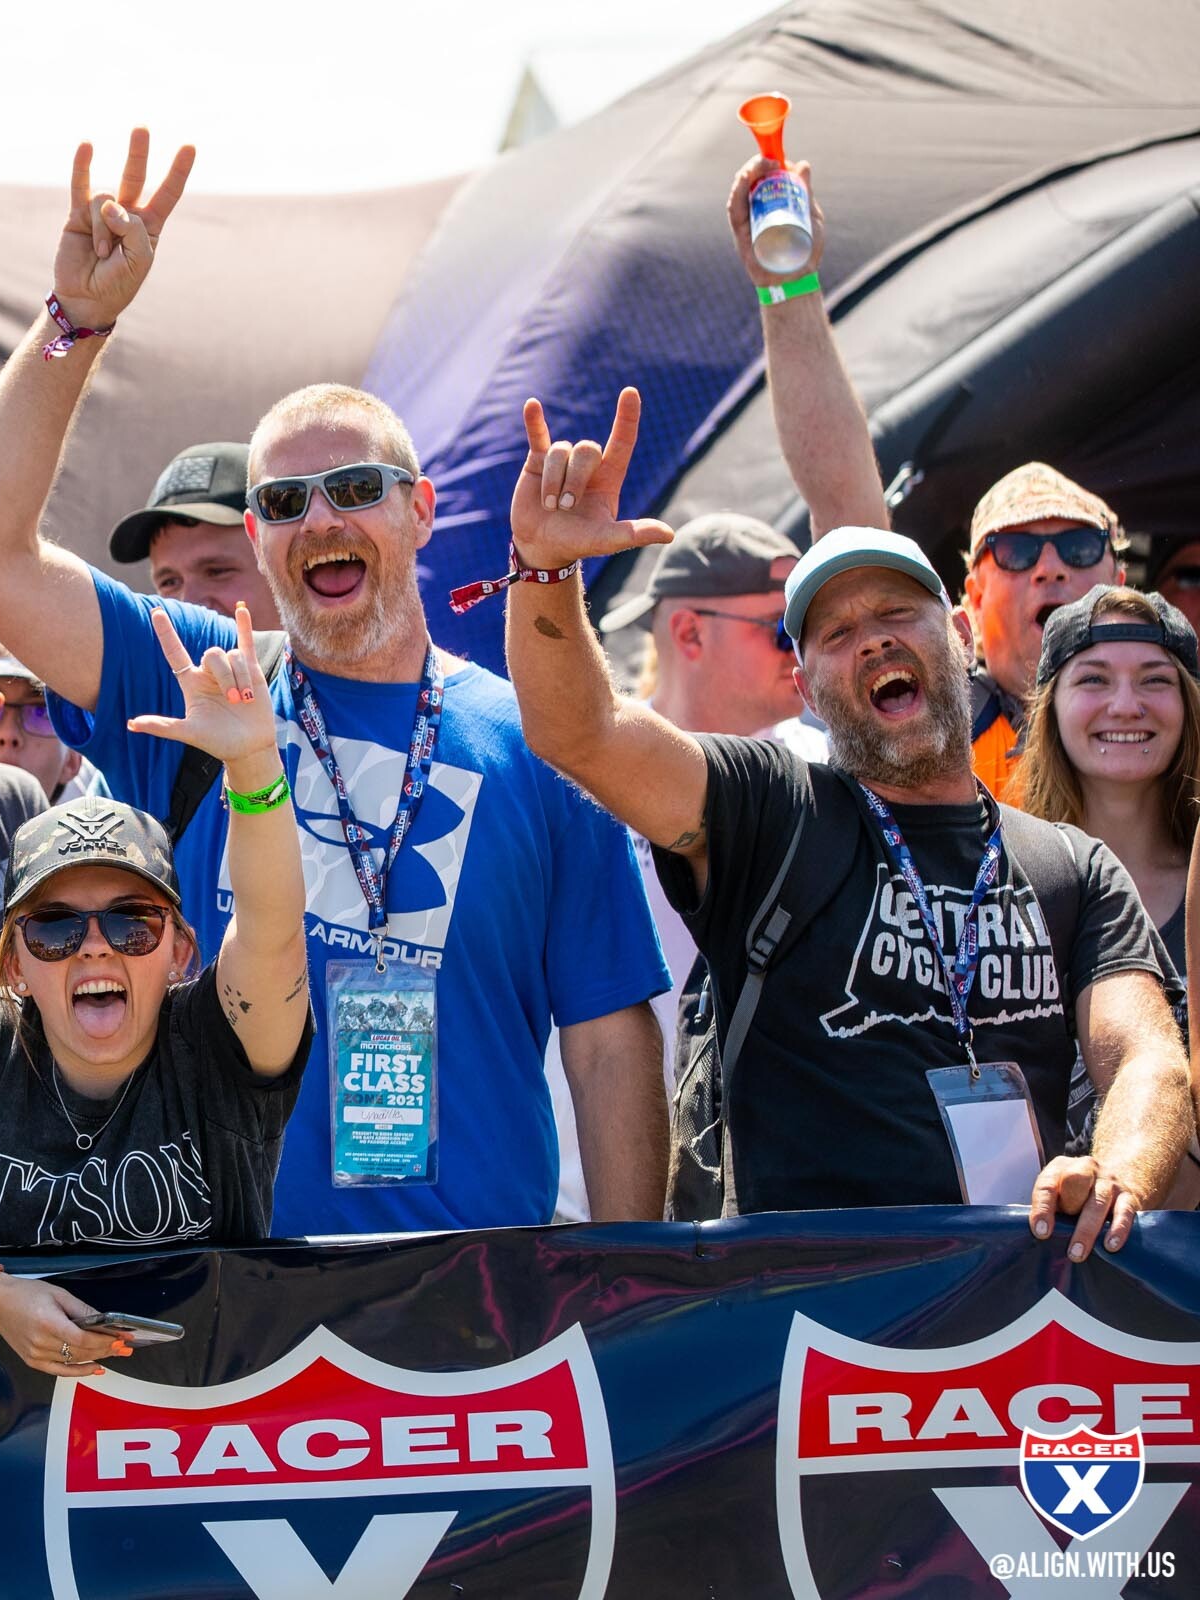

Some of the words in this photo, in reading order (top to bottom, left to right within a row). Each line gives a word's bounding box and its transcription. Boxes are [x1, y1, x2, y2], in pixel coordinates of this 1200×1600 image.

[411, 715, 426, 768] MOTOCROSS
[57, 841, 128, 857] VORTEX
[309, 922, 443, 969] ARMOUR
[980, 954, 1060, 1000] CLUB
[350, 1053, 423, 1074] FIRST
[360, 1043, 411, 1051] MOTOCROSS
[343, 1072, 426, 1094] CLASS
[343, 1093, 384, 1105] ZONE
[386, 1094, 424, 1107] 2021
[827, 1382, 1194, 1443] RACE
[96, 1409, 556, 1480] RACER
